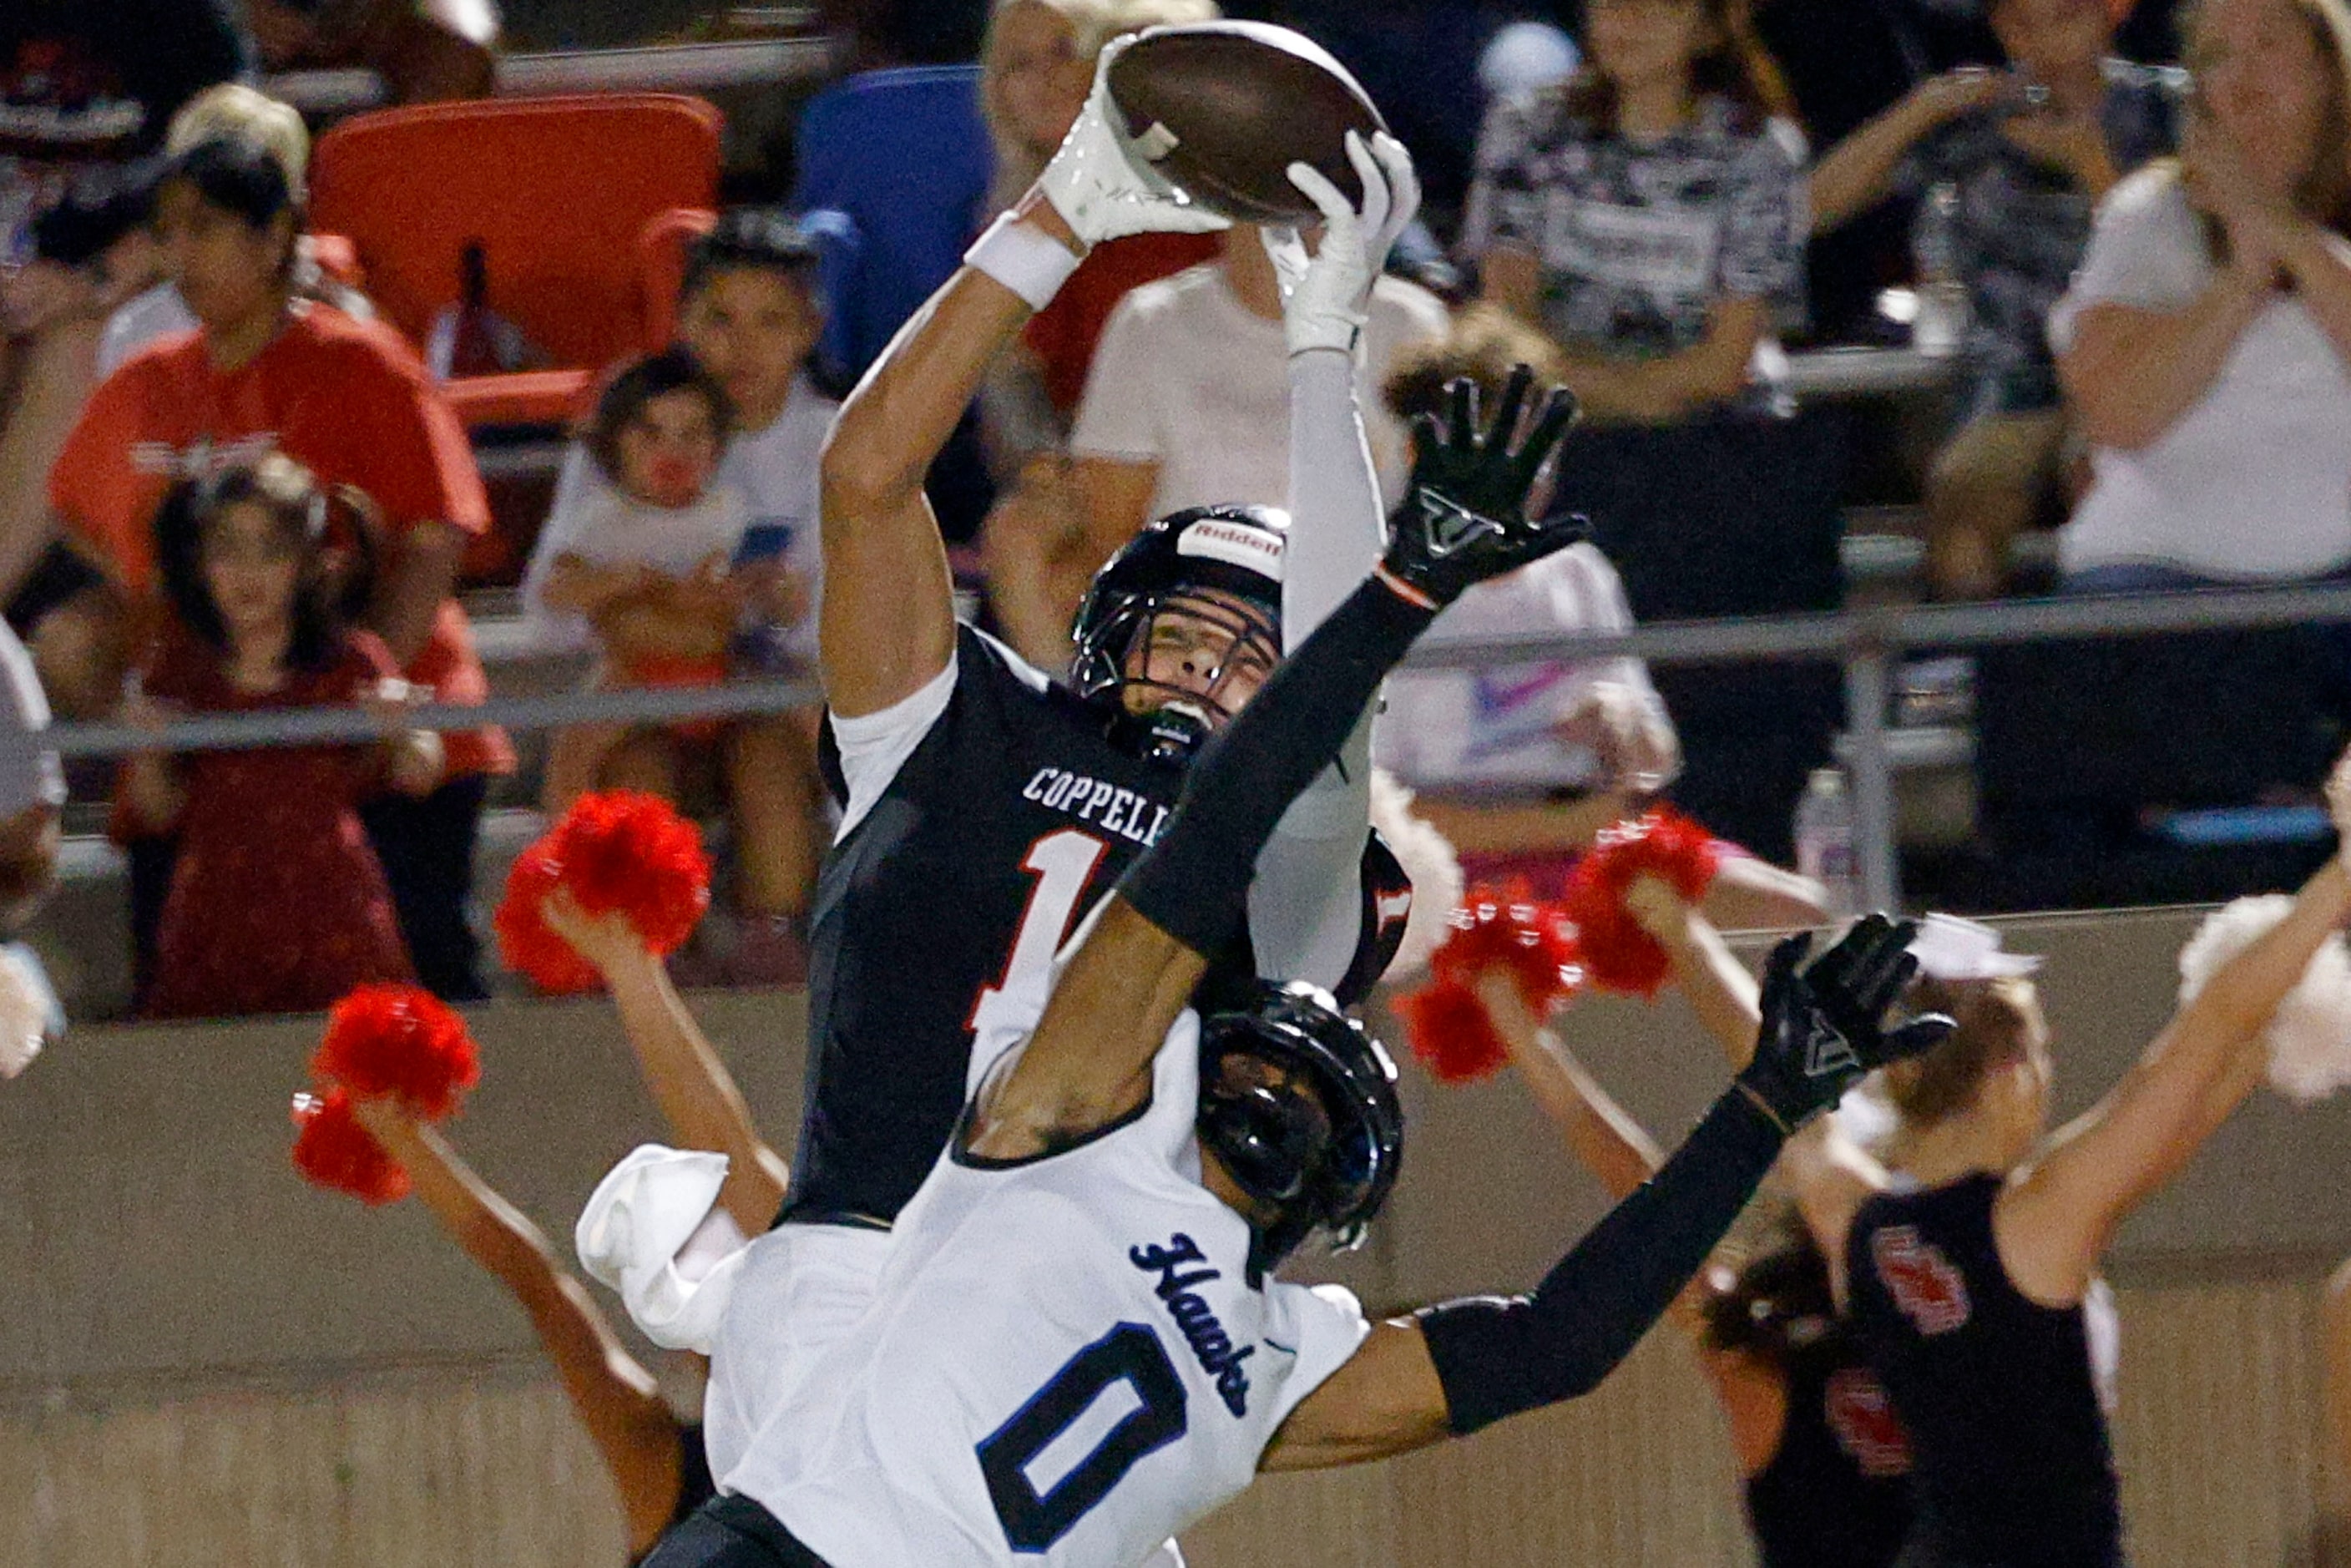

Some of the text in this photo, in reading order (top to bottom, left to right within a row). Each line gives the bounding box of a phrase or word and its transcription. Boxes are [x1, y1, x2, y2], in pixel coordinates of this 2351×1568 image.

[1195, 524, 1281, 557] Riddell
[963, 825, 1110, 1032] 1
[1130, 1232, 1255, 1419] Hawks
[975, 1321, 1187, 1555] 0
